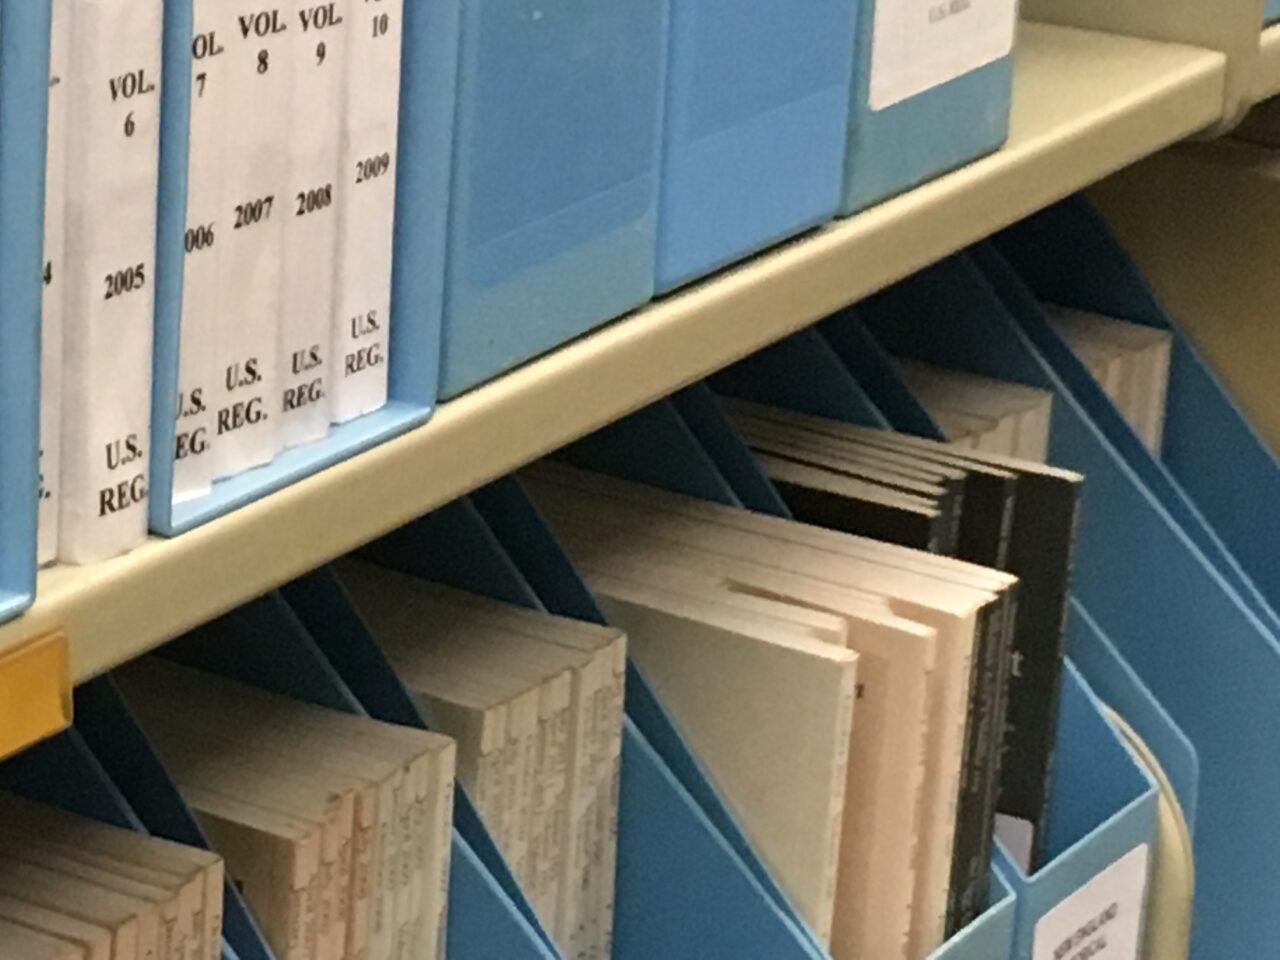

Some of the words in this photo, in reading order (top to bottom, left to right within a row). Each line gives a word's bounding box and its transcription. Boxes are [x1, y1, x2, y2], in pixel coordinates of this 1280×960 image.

[238, 9, 287, 39] VOL.
[299, 2, 343, 33] VOL.
[372, 13, 389, 39] 10
[192, 32, 224, 60] OL.
[316, 41, 326, 67] 9
[257, 50, 268, 75] 8
[109, 69, 155, 102] VOL.
[196, 73, 207, 98] 7
[124, 112, 135, 137] 6
[355, 151, 390, 184] 2009
[234, 196, 274, 230] 2007
[295, 183, 332, 217] 2008
[184, 223, 215, 253] 006
[104, 262, 145, 301] 2005
[351, 310, 380, 339] U.S.
[225, 358, 262, 392] U.S.
[291, 344, 322, 375] U.S.
[344, 343, 384, 378] REG.
[282, 377, 325, 414] REG.
[217, 397, 267, 436] REG.
[105, 434, 143, 470] U.S.
[174, 427, 210, 460] EG.
